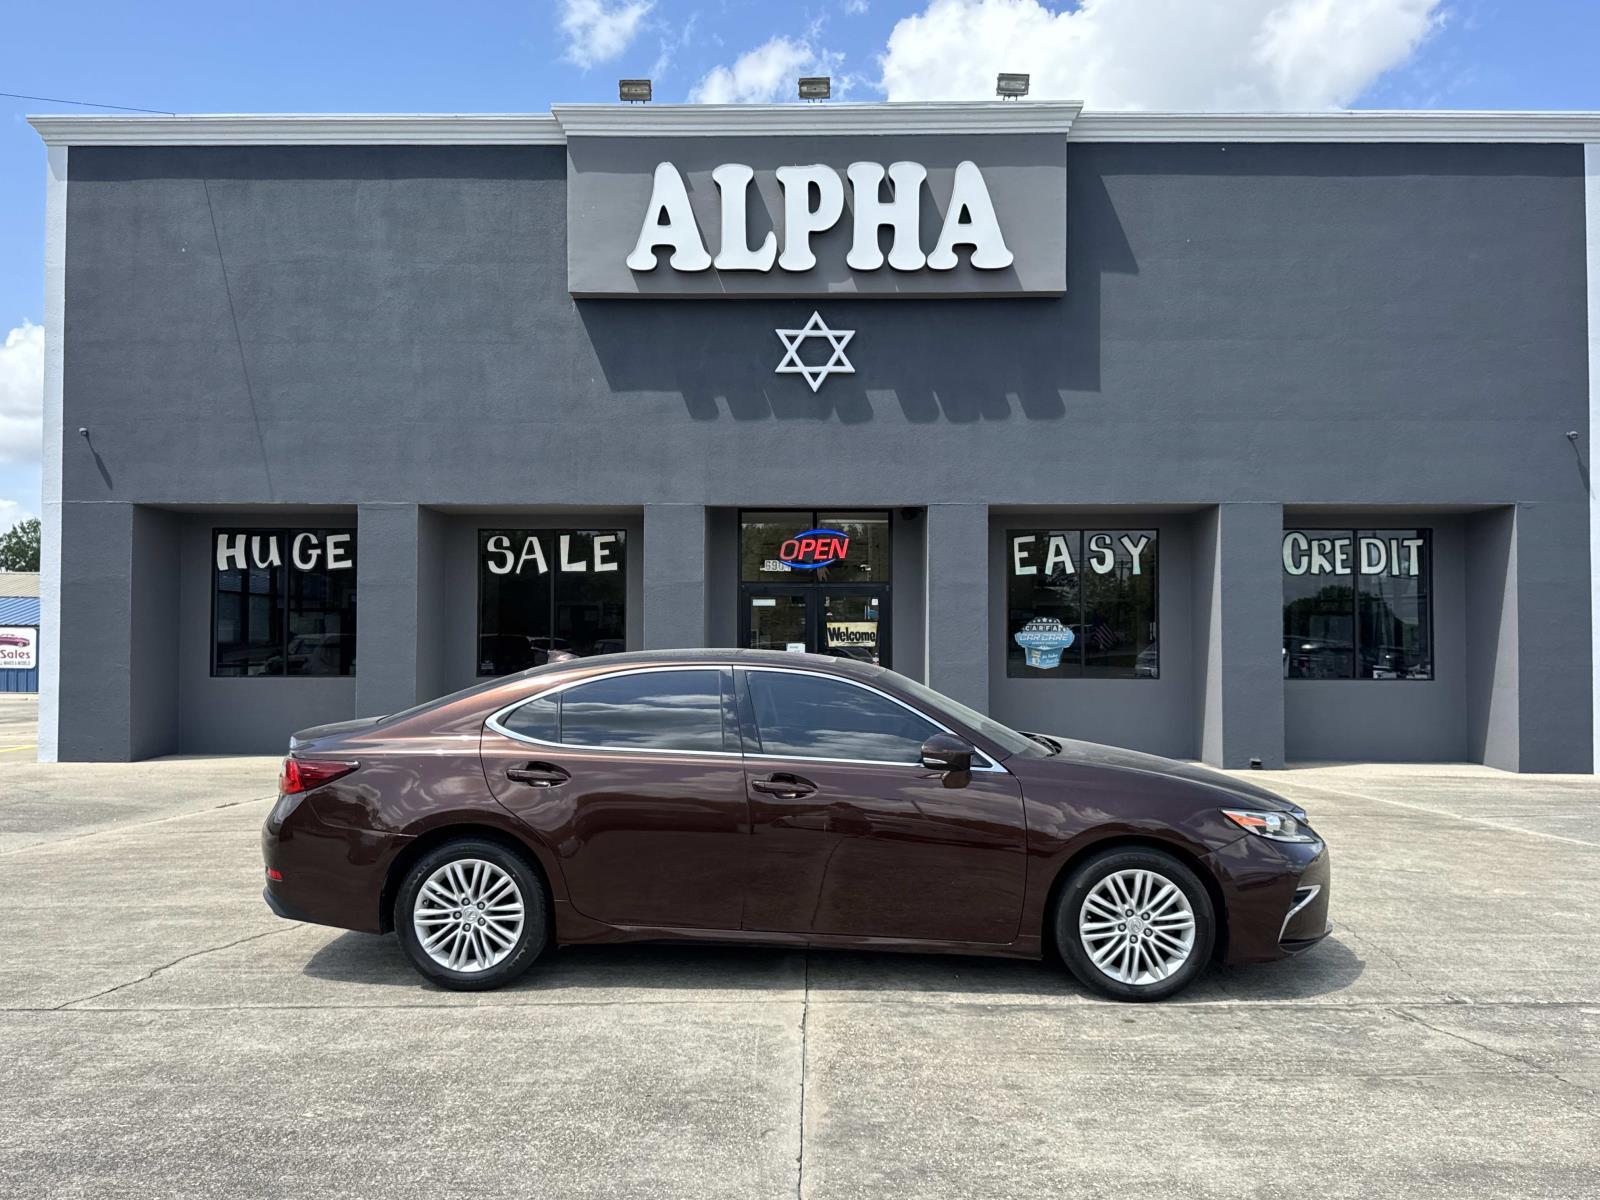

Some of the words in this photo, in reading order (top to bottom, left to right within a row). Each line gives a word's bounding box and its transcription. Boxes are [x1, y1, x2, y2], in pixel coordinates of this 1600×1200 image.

[625, 160, 1014, 272] ALPHA
[216, 532, 353, 571] HUGE
[487, 534, 618, 575] SALE
[779, 538, 850, 560] OPEN
[1012, 534, 1150, 576] EASY
[1282, 532, 1424, 576] CREDIT
[0, 649, 31, 659] Sales
[827, 627, 876, 642] Welcome
[1019, 633, 1041, 641] CAR
[1041, 633, 1069, 641] CARE
